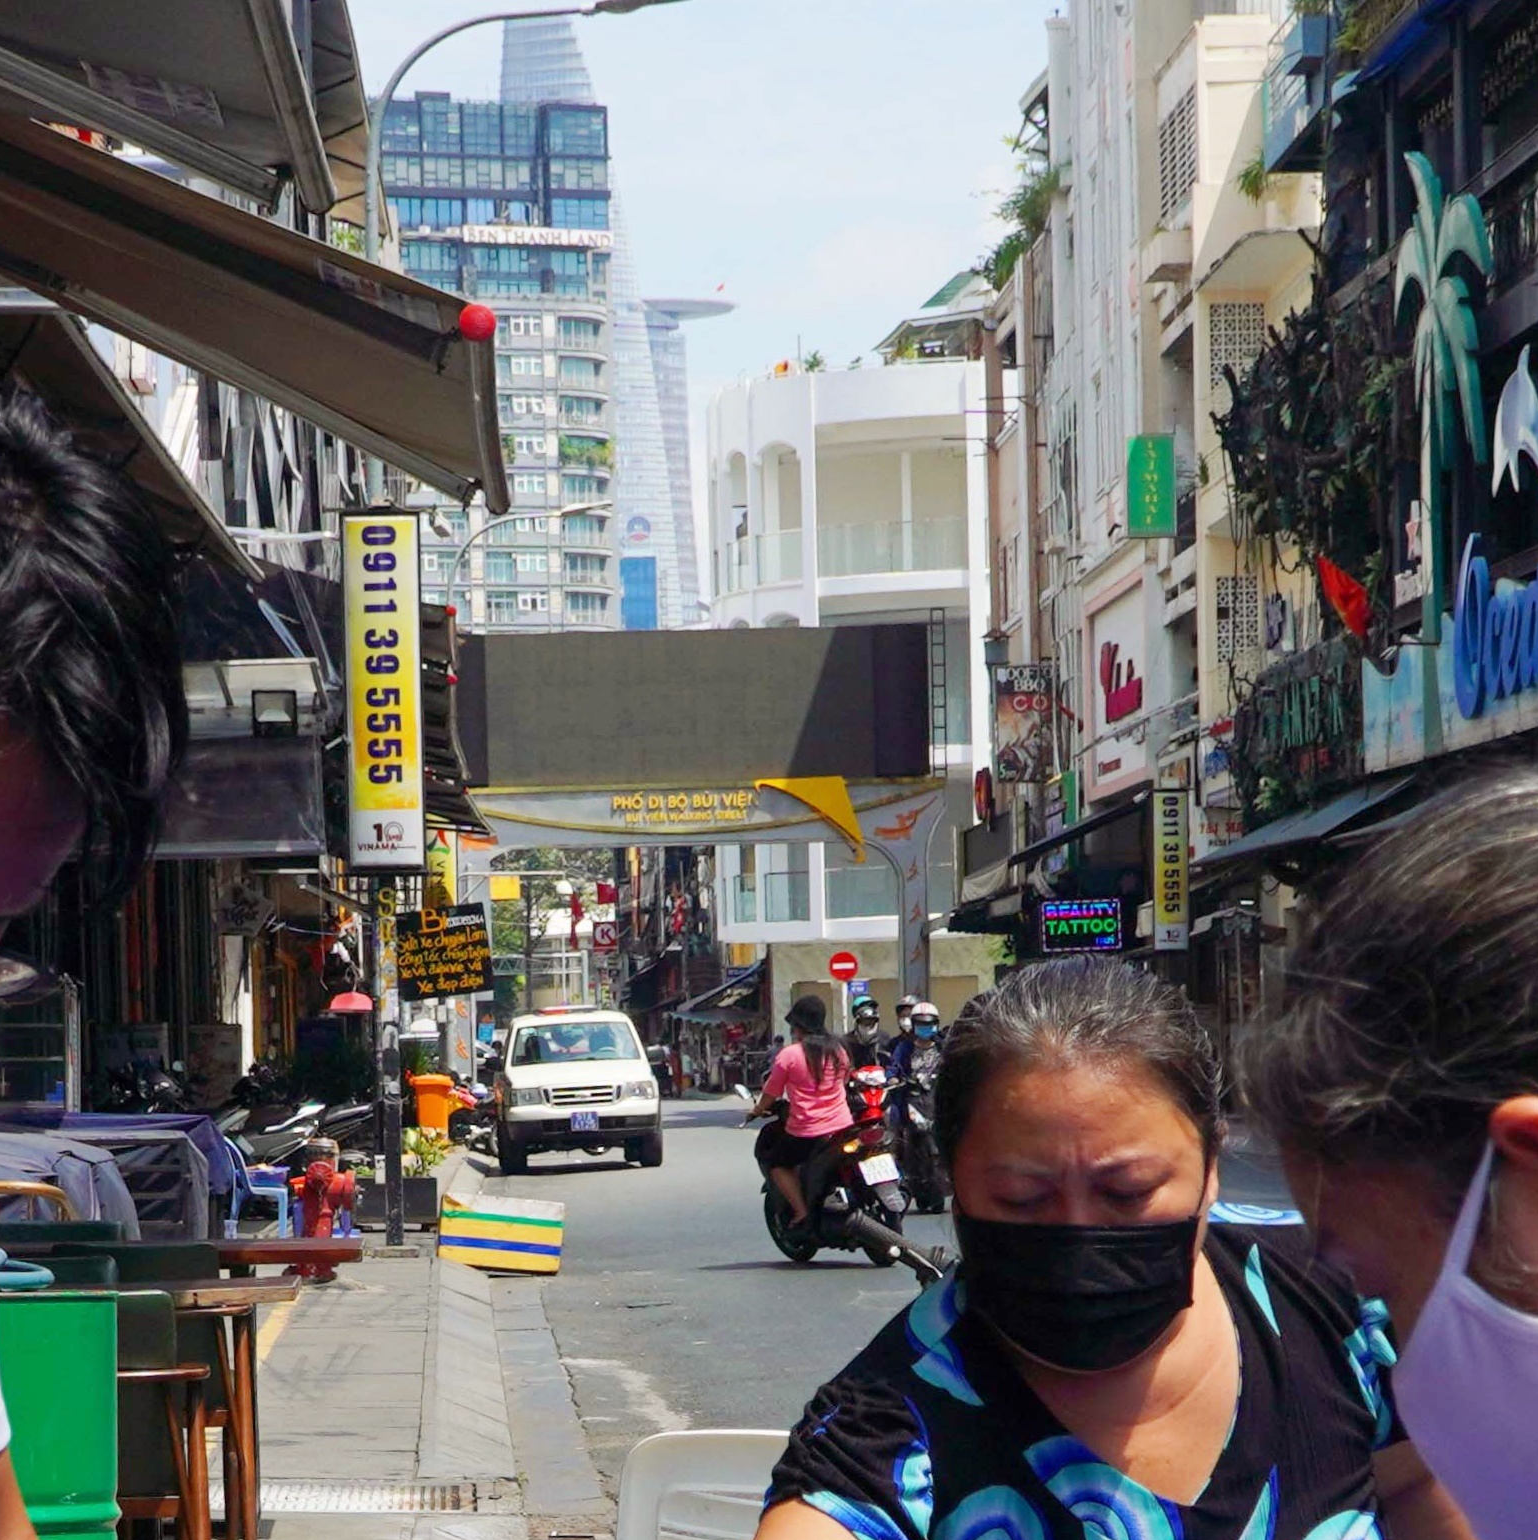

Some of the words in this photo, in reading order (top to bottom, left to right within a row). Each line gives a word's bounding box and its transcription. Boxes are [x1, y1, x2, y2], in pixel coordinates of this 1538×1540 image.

[362, 525, 397, 614] 0911
[364, 629, 399, 676] 39
[366, 687, 402, 785] 5555
[613, 791, 644, 809] PHỐ
[648, 795, 663, 808] DI
[667, 792, 688, 812] BỘ
[693, 790, 718, 808] BÙI
[1162, 796, 1179, 837] 0911
[357, 843, 398, 852] VINAMA
[1163, 843, 1180, 864] 39
[1164, 869, 1181, 913] 5555
[1045, 903, 1116, 918] BEAUTY
[601, 928, 612, 940] K
[1045, 918, 1117, 935] TATTOO
